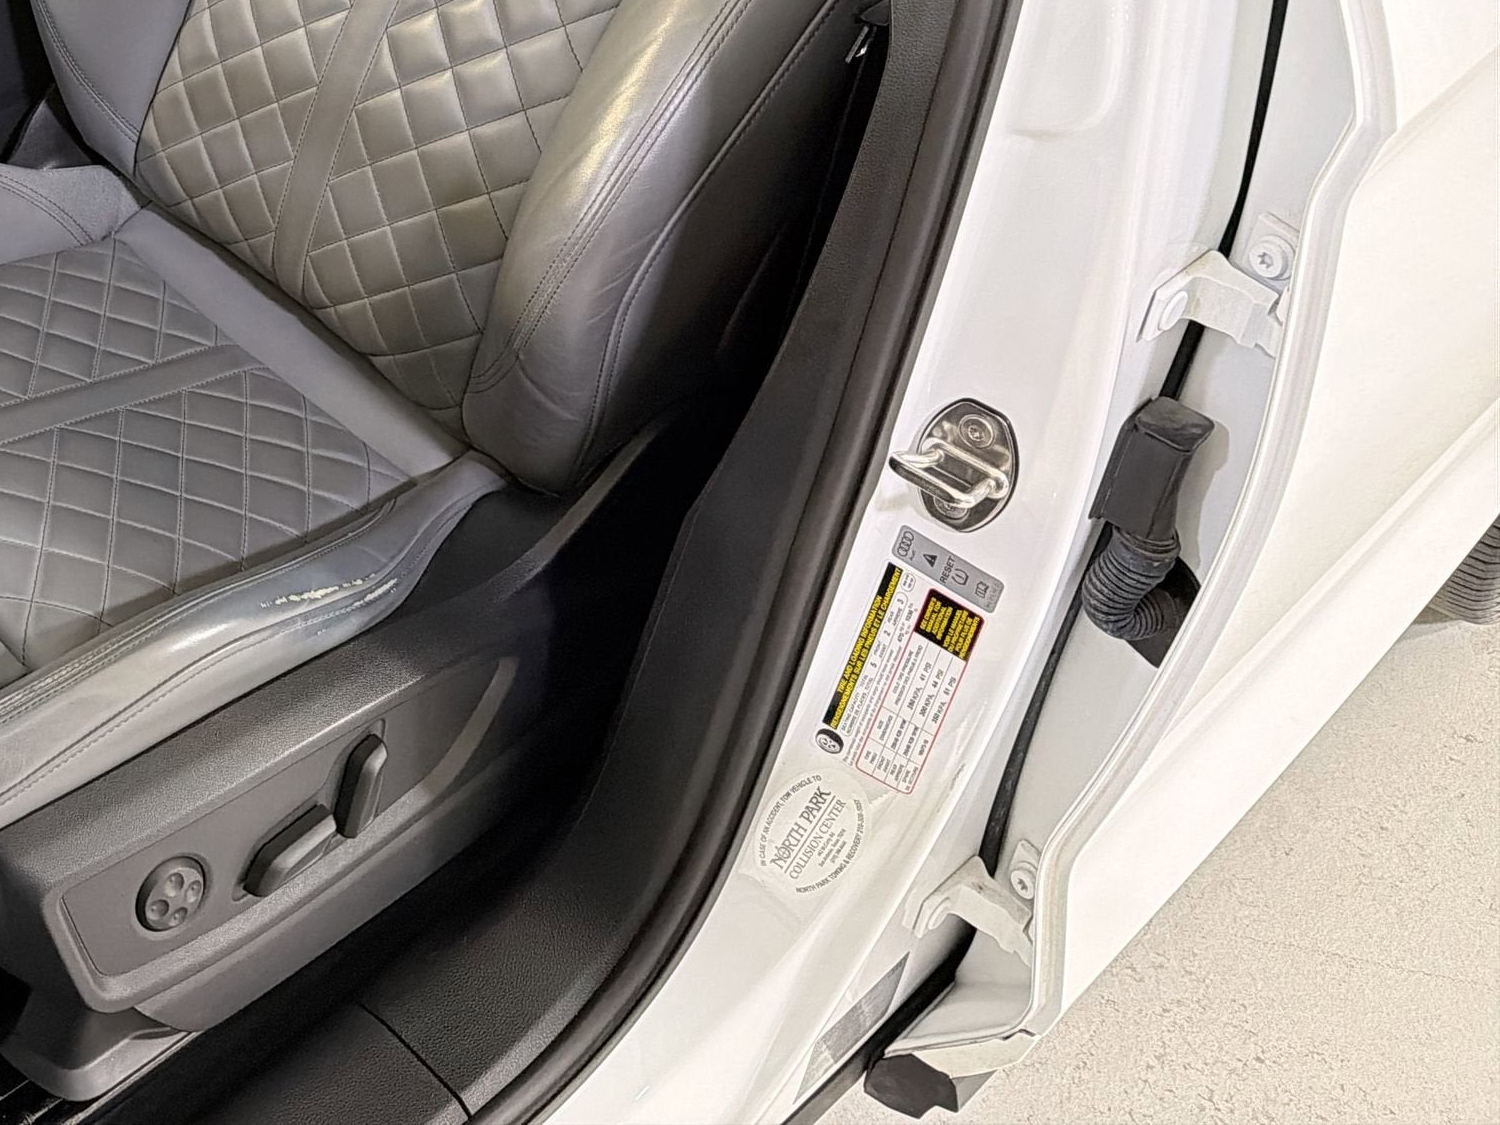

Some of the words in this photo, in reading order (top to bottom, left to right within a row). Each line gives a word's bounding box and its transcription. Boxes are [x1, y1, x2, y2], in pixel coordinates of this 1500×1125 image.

[939, 555, 956, 584] RESET
[880, 567, 901, 609] CHARGEMENT
[873, 619, 880, 627] ET
[876, 609, 884, 619] LE
[837, 678, 846, 692] TIRE
[843, 665, 852, 678] AND
[849, 637, 864, 664] LOADING
[860, 595, 881, 637] INFORMATION
[864, 627, 876, 647] PNEUS
[858, 647, 868, 660] LES
[853, 660, 863, 674] SUR
[830, 673, 857, 728] RENSEIGNEMENTS
[812, 775, 822, 783] TO
[770, 821, 808, 870] NORTH
[799, 786, 832, 825] PARK
[789, 831, 824, 880] COLLISION
[819, 799, 847, 835] CENTER
[816, 878, 830, 888] PARK
